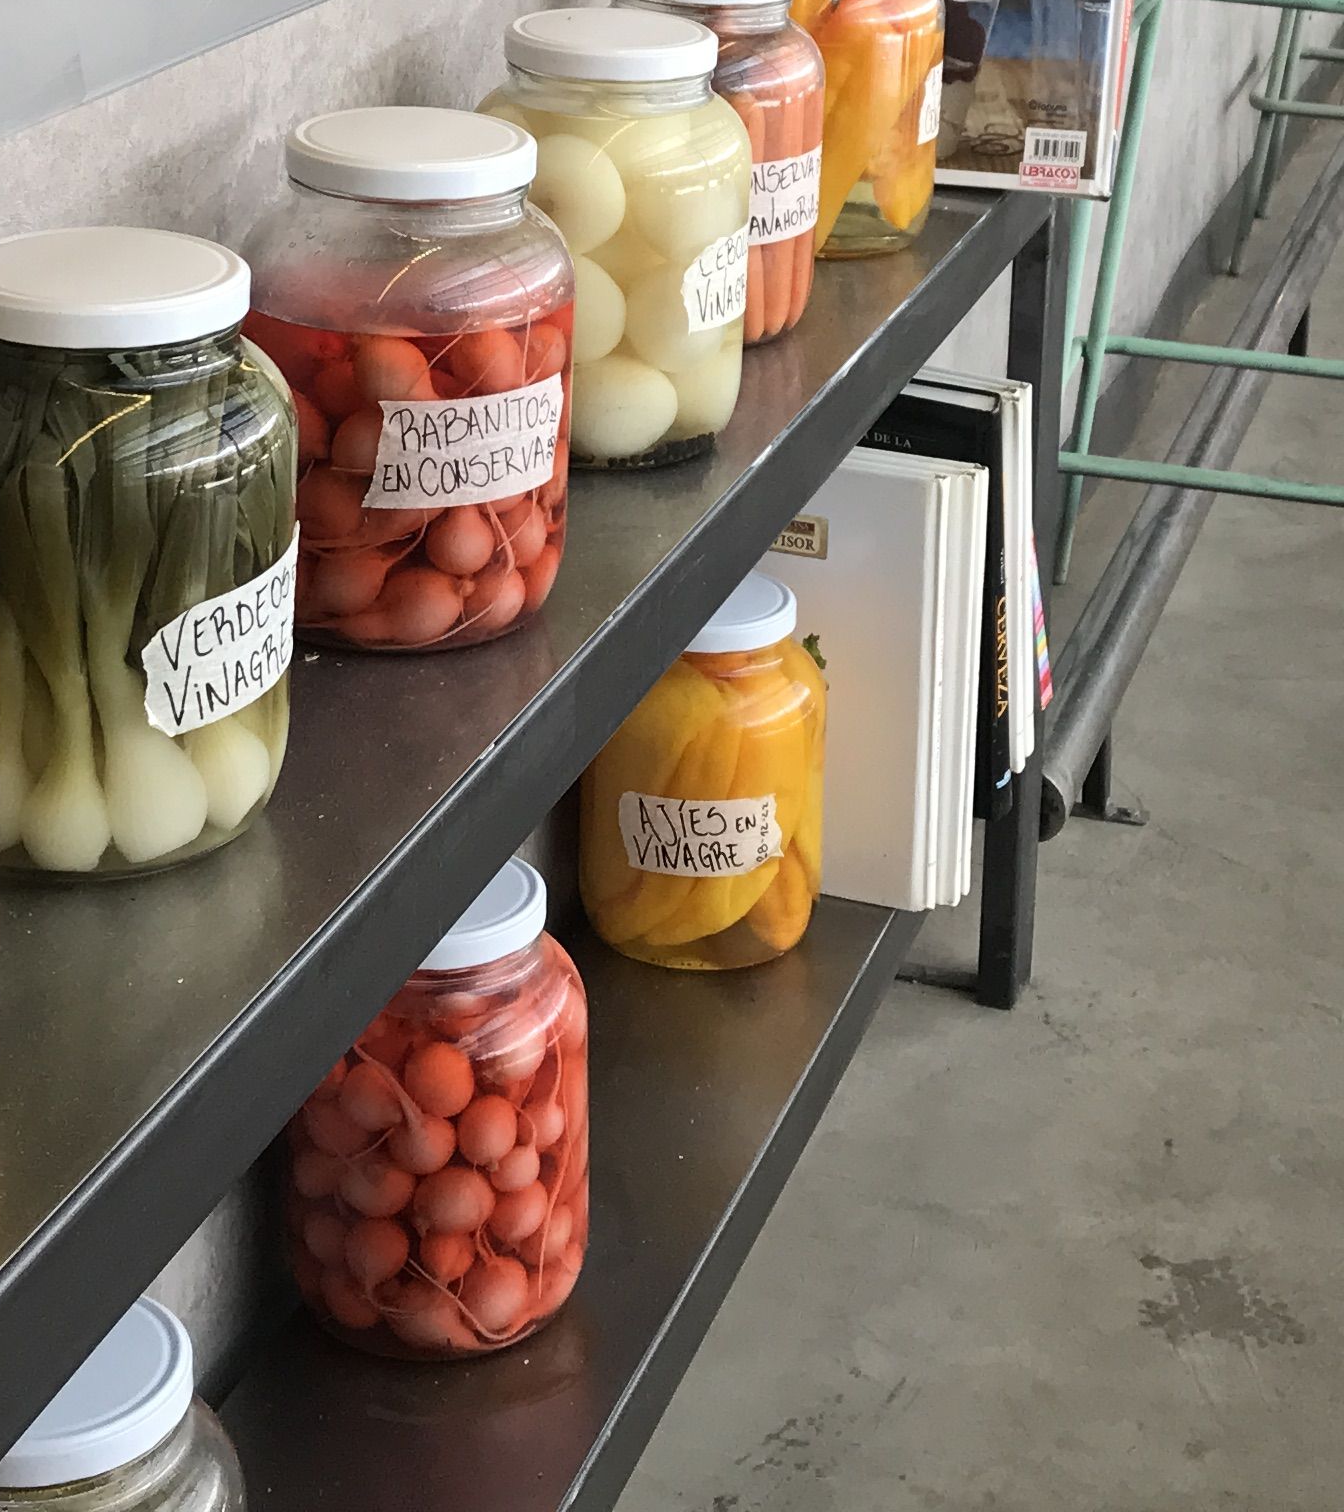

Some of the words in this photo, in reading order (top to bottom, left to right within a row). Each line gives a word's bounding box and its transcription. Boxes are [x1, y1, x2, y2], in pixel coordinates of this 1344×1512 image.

[389, 392, 551, 454] RABANITOS
[873, 431, 891, 444] DE
[895, 436, 912, 449] LA
[382, 462, 411, 493] EN
[418, 435, 546, 498] CONSERVA
[161, 565, 290, 672] VERDEOS
[163, 617, 291, 727] VINAGRE
[633, 834, 744, 872] VINAGRE
[735, 814, 757, 833] EN
